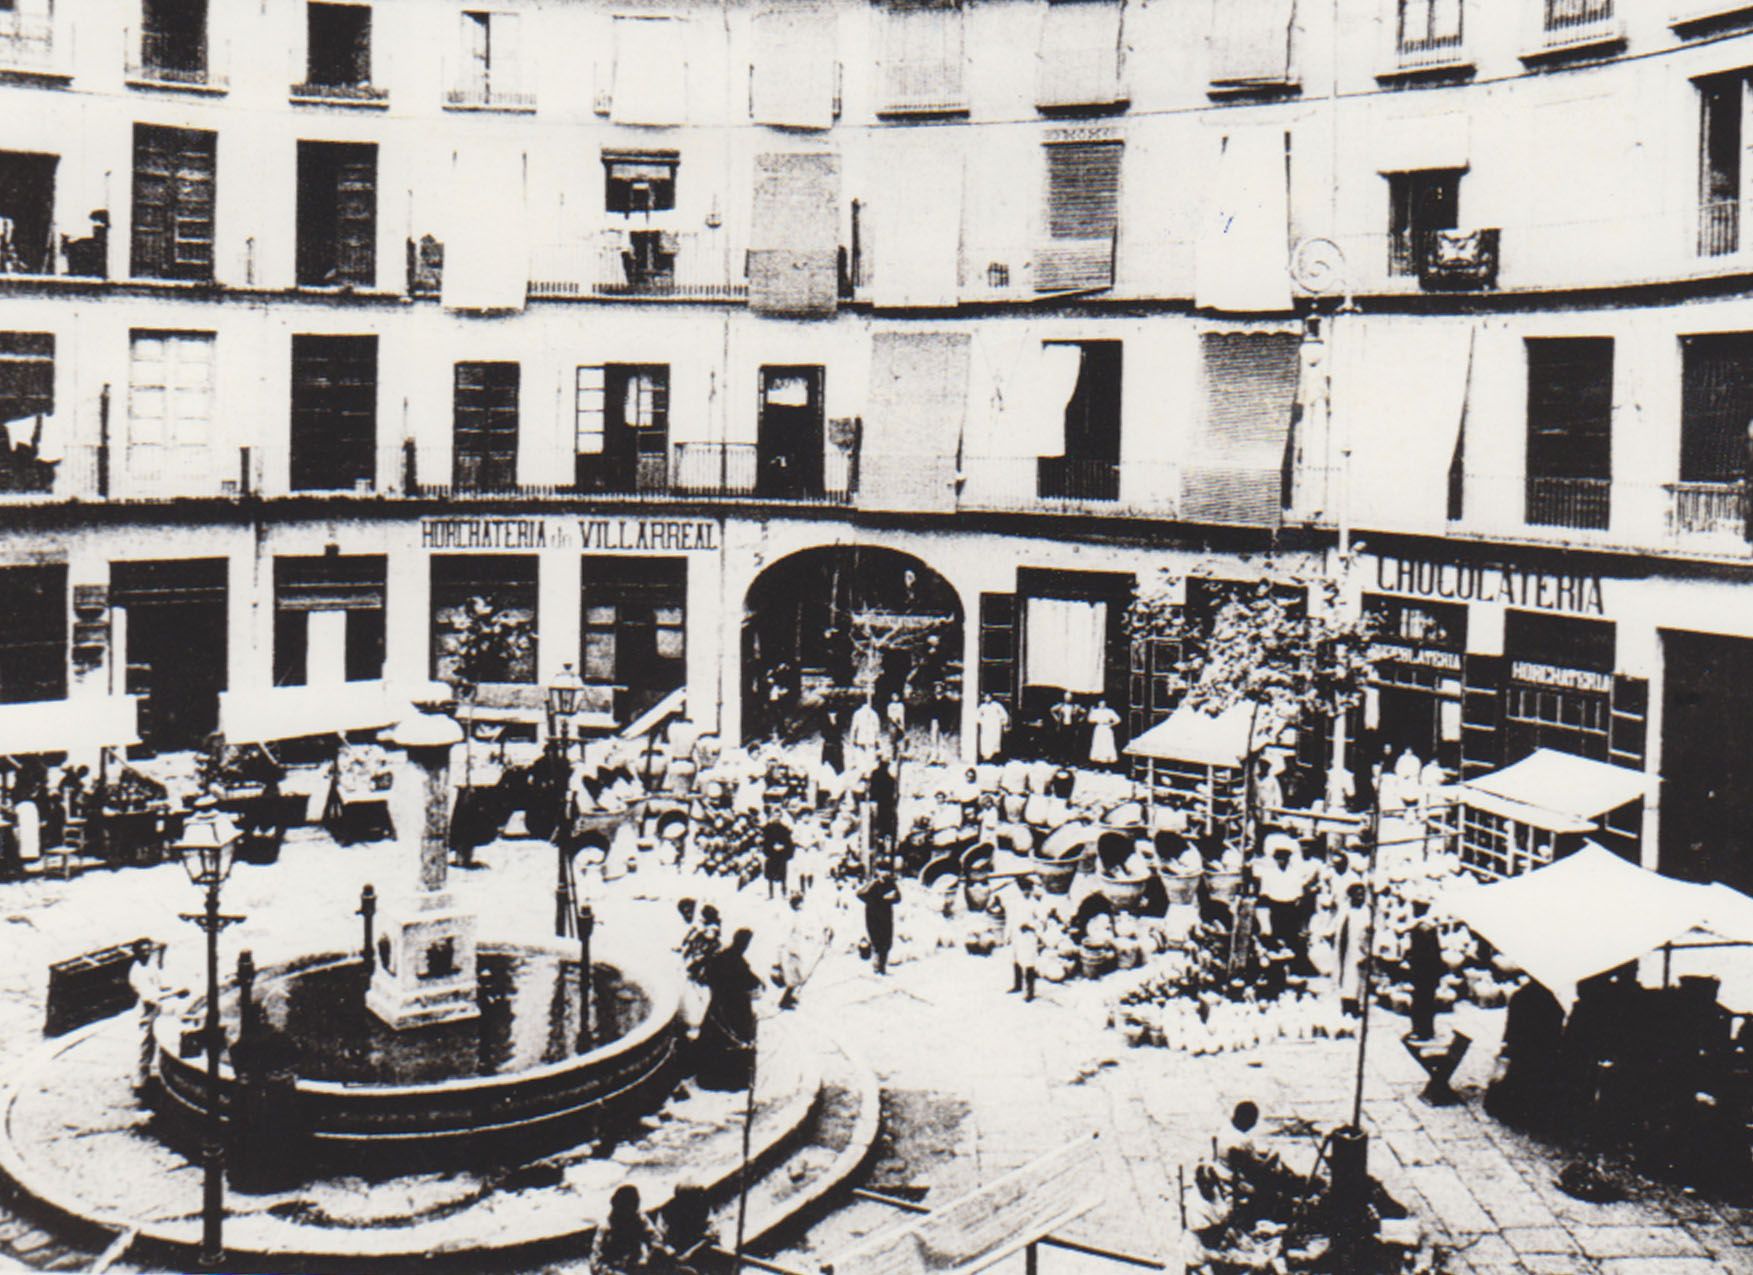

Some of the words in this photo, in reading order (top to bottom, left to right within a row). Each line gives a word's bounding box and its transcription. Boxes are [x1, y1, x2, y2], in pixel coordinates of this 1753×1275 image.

[421, 519, 546, 548] HORCHATERIA
[578, 520, 719, 550] VILLARREAL
[1376, 553, 1604, 616] CHOCOLATERIA
